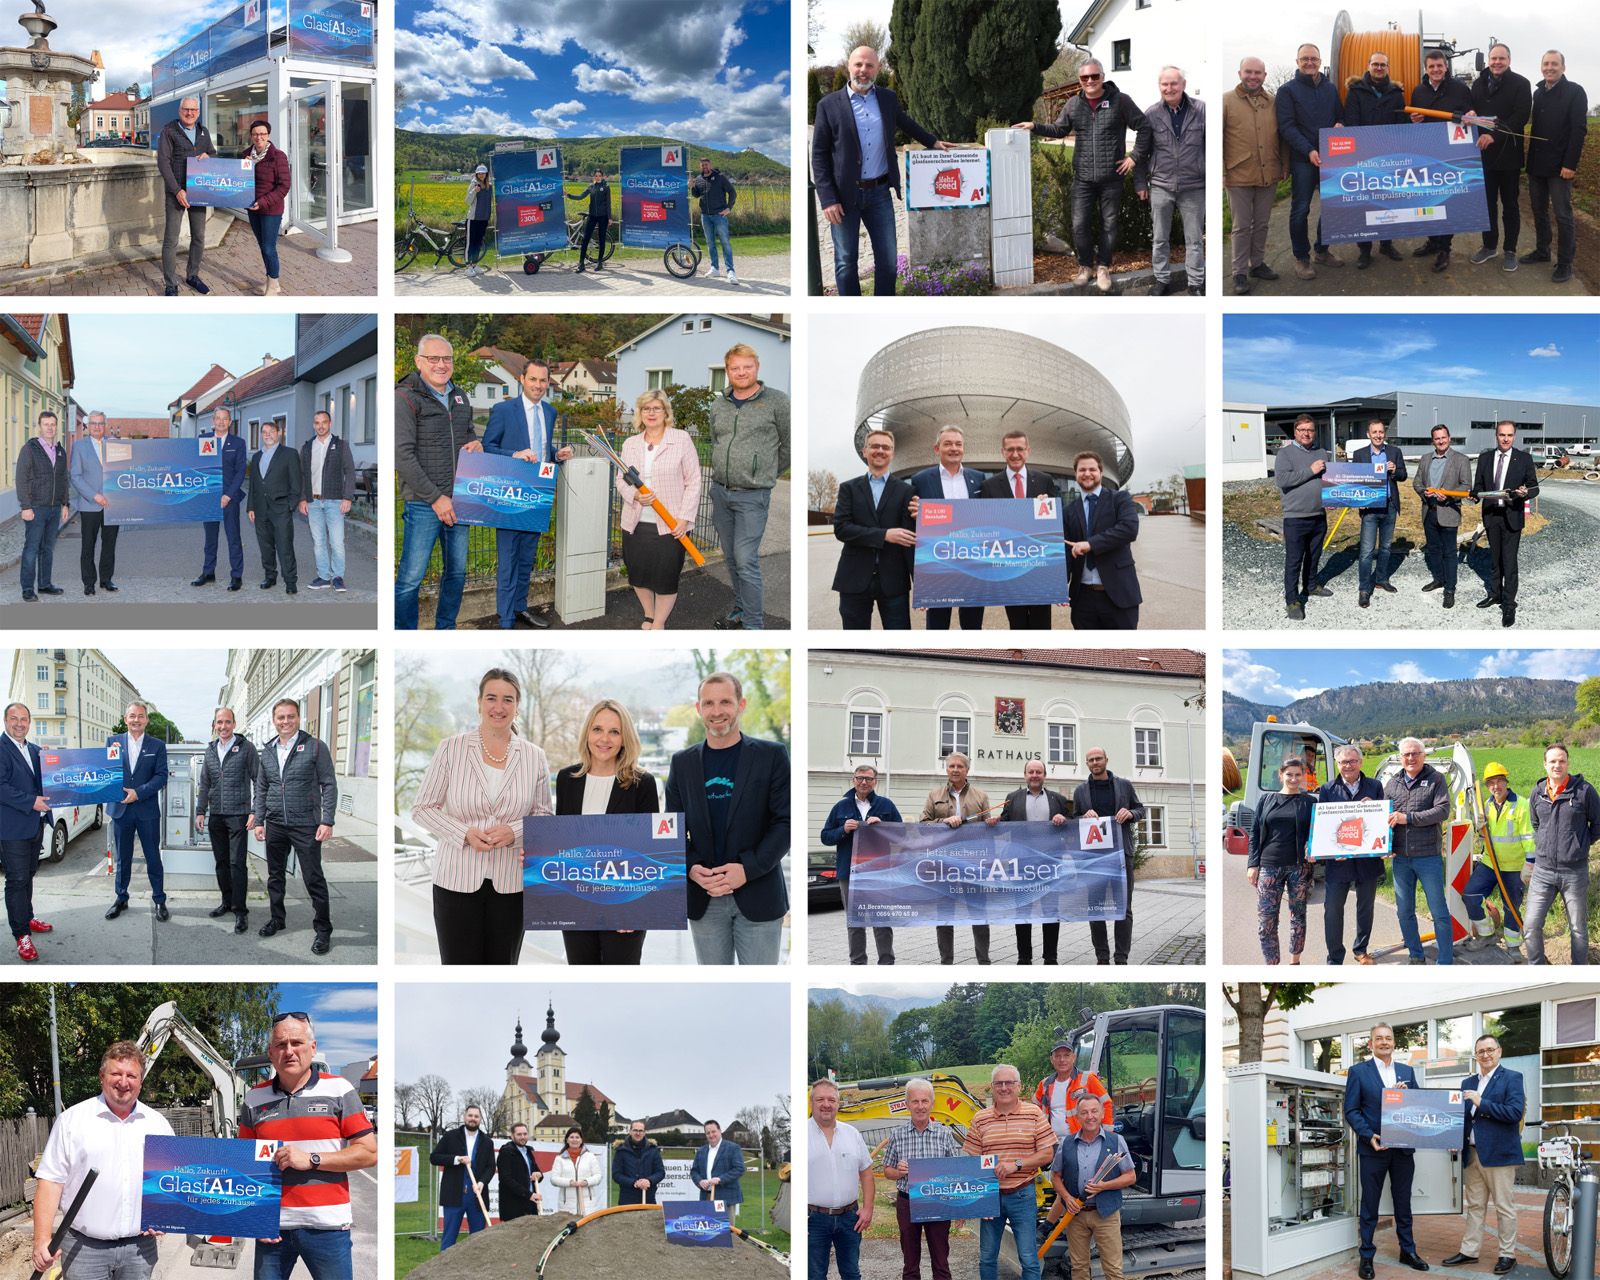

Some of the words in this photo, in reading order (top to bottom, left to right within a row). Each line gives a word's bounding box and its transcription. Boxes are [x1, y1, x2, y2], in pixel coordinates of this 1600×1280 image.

[302, 14, 362, 39] GlasfA1ser
[1453, 125, 1469, 141] A1
[540, 151, 554, 167] A1
[664, 150, 679, 163] A1
[1381, 158, 1413, 167] Zukunft!
[194, 176, 247, 188] GlasfA1ser
[627, 178, 680, 189] GlasfA1ser
[935, 180, 957, 191] Speed
[1340, 166, 1466, 192] GlasfA1ser
[501, 182, 557, 195] GlasfA1ser
[970, 187, 984, 202] A1
[1356, 192, 1370, 201] die
[1371, 189, 1424, 202] Impulsregion
[201, 441, 215, 454] A1
[541, 466, 553, 476] A1
[117, 472, 210, 490] GlasfA1ser
[466, 480, 544, 503] GlasfA1ser
[1329, 490, 1379, 498] GlasfA1ser
[1038, 501, 1053, 516] A1
[970, 530, 1000, 538] Zukunft!
[933, 540, 1049, 560] GlasfA1ser
[109, 749, 118, 758] A1
[977, 749, 1042, 761] RATHAUS
[52, 771, 114, 784] GlasfA1ser
[657, 817, 674, 835] A1
[1085, 821, 1107, 845] A1
[1338, 830, 1359, 840] Speed
[1371, 835, 1386, 850] A1
[558, 849, 584, 859] Hallo,
[585, 848, 623, 858] Zukunft!
[926, 848, 947, 858] Jetzt
[949, 847, 989, 857] sichern!
[541, 860, 668, 882] GlasfA1ser
[915, 857, 1063, 883] GlasfA1ser
[576, 883, 589, 892] für
[591, 883, 616, 894] jedes
[618, 882, 659, 892] Zuhause.
[949, 885, 964, 894] bis
[966, 886, 977, 894] in
[867, 903, 912, 911] Beratungsteam
[1451, 1093, 1460, 1102] A1
[1391, 1112, 1454, 1126] GlasfA1ser
[258, 1143, 275, 1158] A1
[983, 1157, 993, 1167] A1
[174, 1166, 196, 1175] Hallo,
[197, 1166, 228, 1175] Zukunft!
[159, 1175, 265, 1197] GlasfA1ser
[919, 1182, 990, 1196] GlasfA1ser
[187, 1195, 198, 1203] für
[200, 1196, 221, 1205] jedes
[672, 1221, 723, 1231] GlasfA1ser
